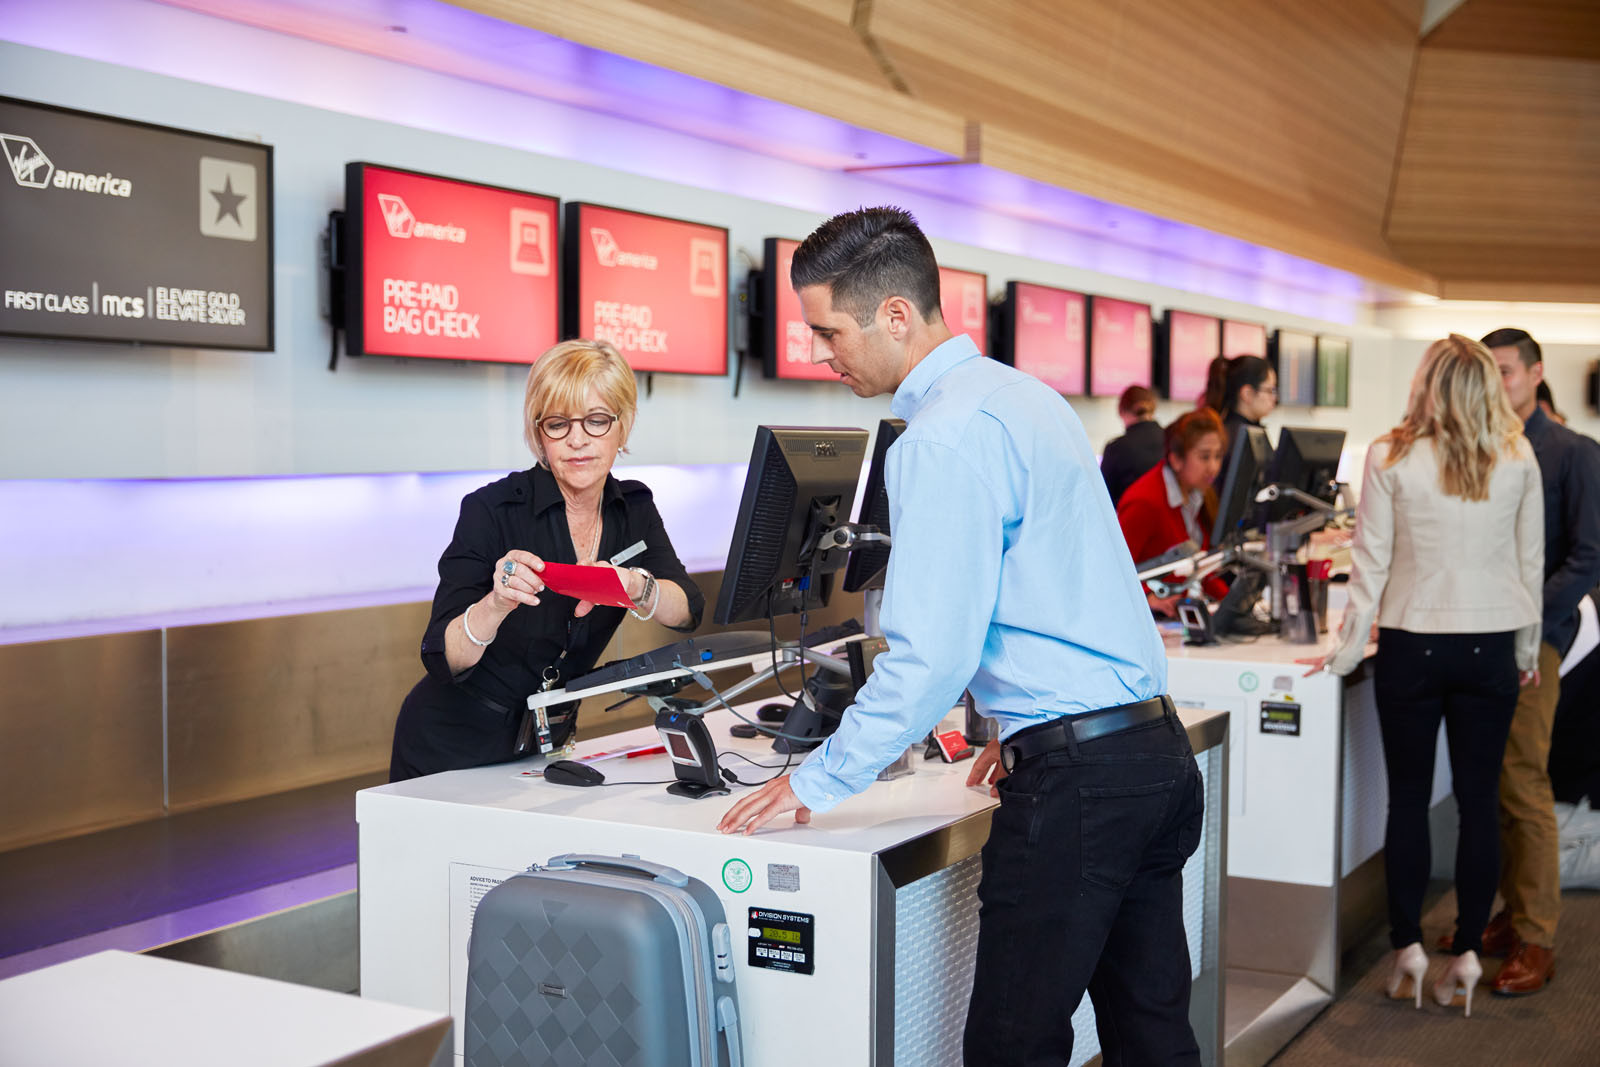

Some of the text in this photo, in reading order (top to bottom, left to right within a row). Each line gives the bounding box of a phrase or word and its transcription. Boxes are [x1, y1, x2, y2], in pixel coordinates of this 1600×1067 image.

[53, 169, 132, 198] america
[413, 221, 467, 243] america
[4, 290, 90, 315] FIRST CLASS
[102, 294, 145, 319] mcs
[156, 286, 241, 311] ELEVATE GOLD
[383, 278, 459, 311] PRE-PAID
[156, 302, 246, 326] ELEVATE SILVER
[383, 306, 481, 340] BAG CHECK
[594, 300, 653, 329] PRE-PAID
[624, 327, 669, 354] CHECK
[758, 911, 782, 920] DIVISION
[782, 914, 810, 924] SYSTEMS
